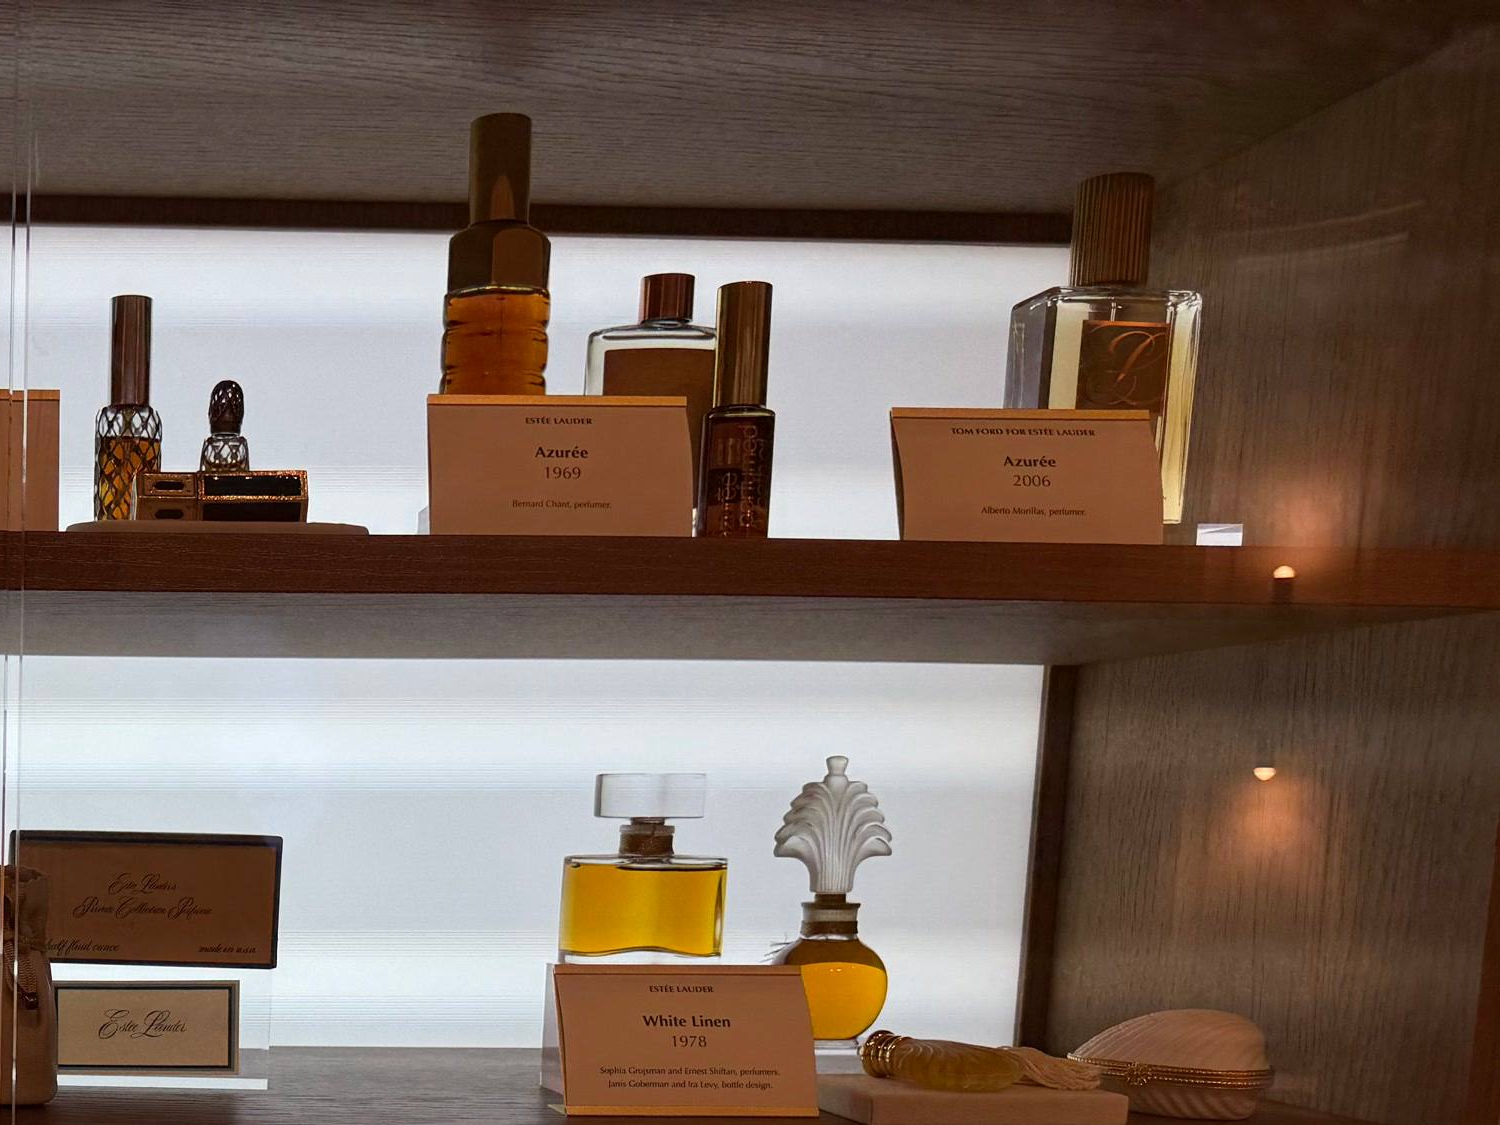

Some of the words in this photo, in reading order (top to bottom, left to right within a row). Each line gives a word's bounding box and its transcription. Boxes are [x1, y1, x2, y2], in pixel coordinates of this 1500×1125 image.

[1006, 428, 1026, 436] FOR
[1057, 428, 1095, 436] LAUDER
[535, 446, 588, 458] Azurée
[1004, 456, 1057, 468] Azurée
[545, 466, 581, 479] 1969
[1013, 475, 1051, 488] 2006
[512, 500, 543, 508] Bernard
[981, 506, 1010, 515] Alberto
[649, 985, 674, 993] ESTÉE
[677, 985, 714, 993] LAUDER
[643, 1015, 687, 1027] White
[692, 1015, 731, 1028] Linen
[672, 1035, 707, 1048] 1978
[600, 1067, 626, 1075] Sophia
[668, 1067, 682, 1075] and
[722, 1081, 745, 1089] bottle
[744, 1081, 772, 1091] design.
